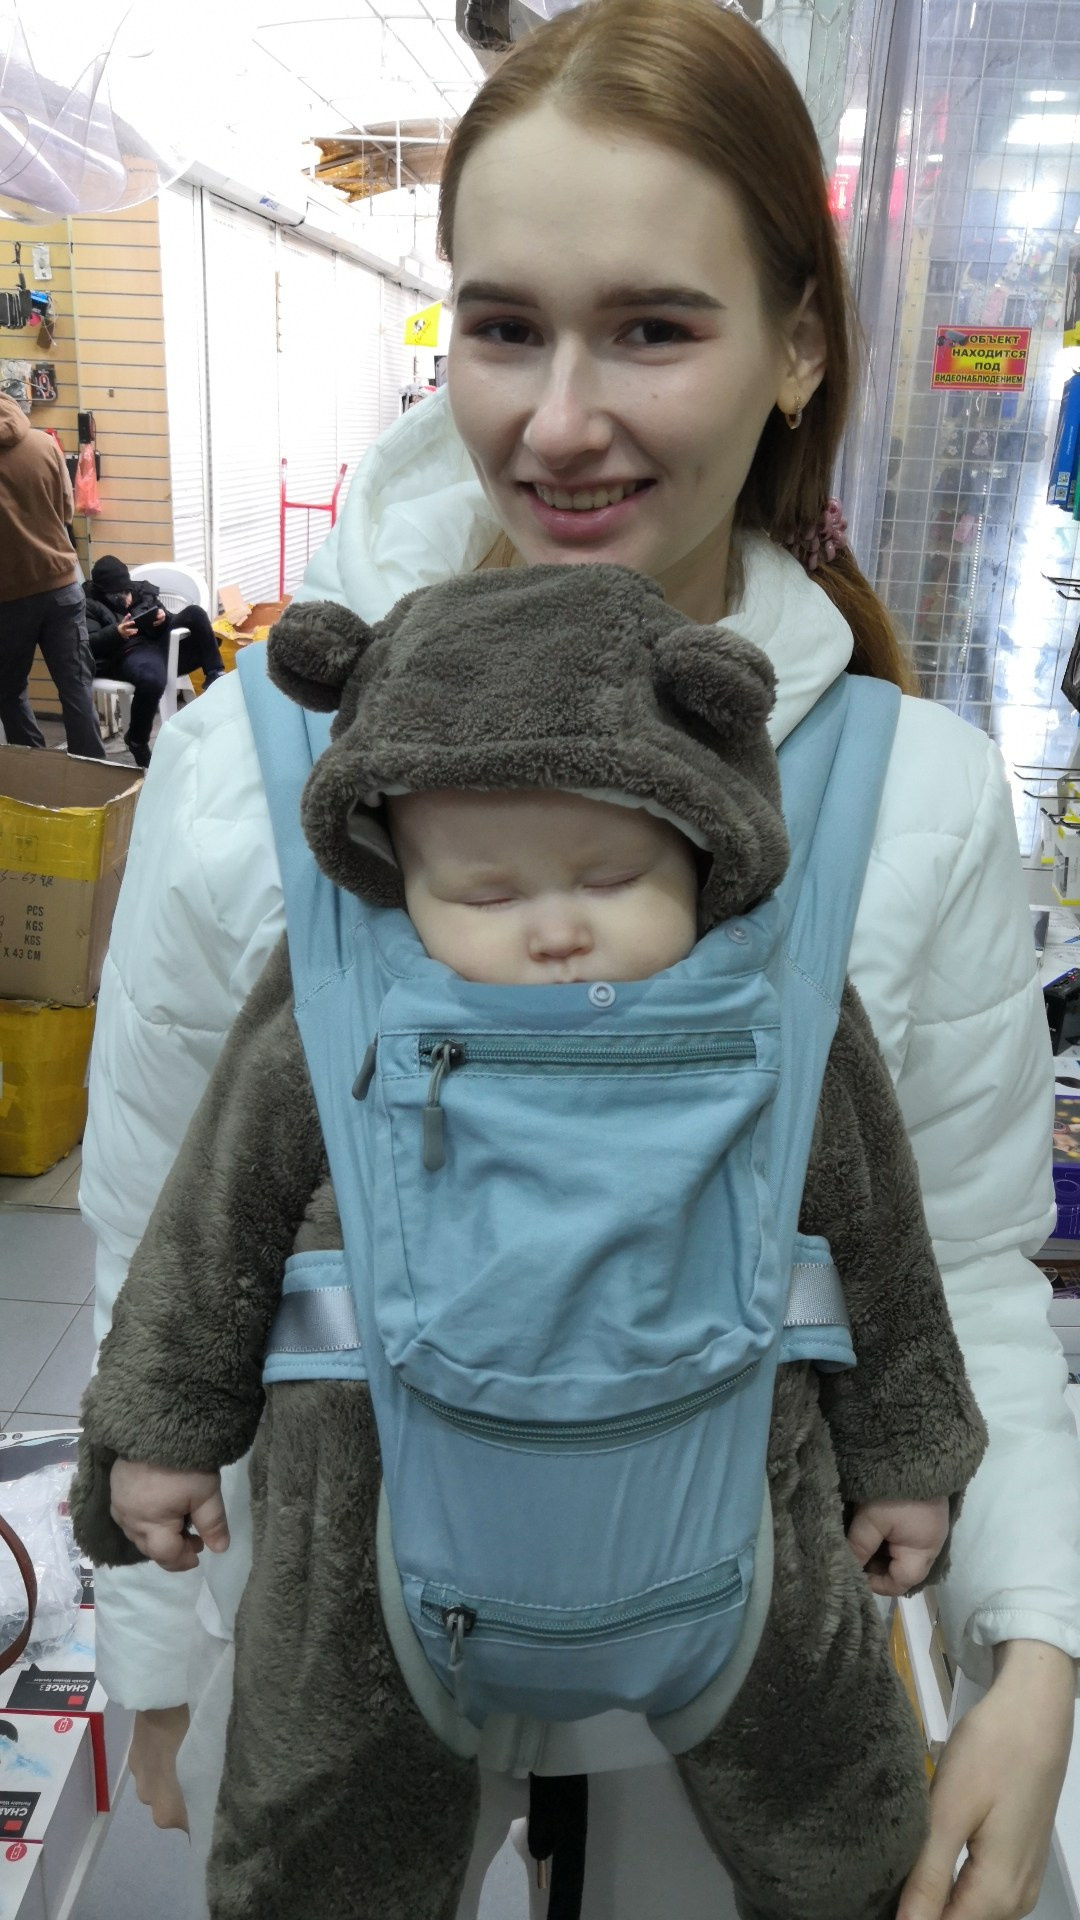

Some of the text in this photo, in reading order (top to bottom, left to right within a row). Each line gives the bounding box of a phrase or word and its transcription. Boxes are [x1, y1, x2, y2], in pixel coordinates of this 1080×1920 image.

[969, 335, 1020, 344] ОБЪЕКТ
[952, 348, 1027, 358] НАХОДИТСЯ
[974, 362, 1001, 372] ПОД
[934, 373, 1023, 384] ВИДЕОНАБЛЮДЕНИЕМ
[26, 905, 44, 917] PCS
[25, 920, 44, 932] KGS
[24, 935, 41, 946] KGS
[3, 947, 41, 960] X 43 CM
